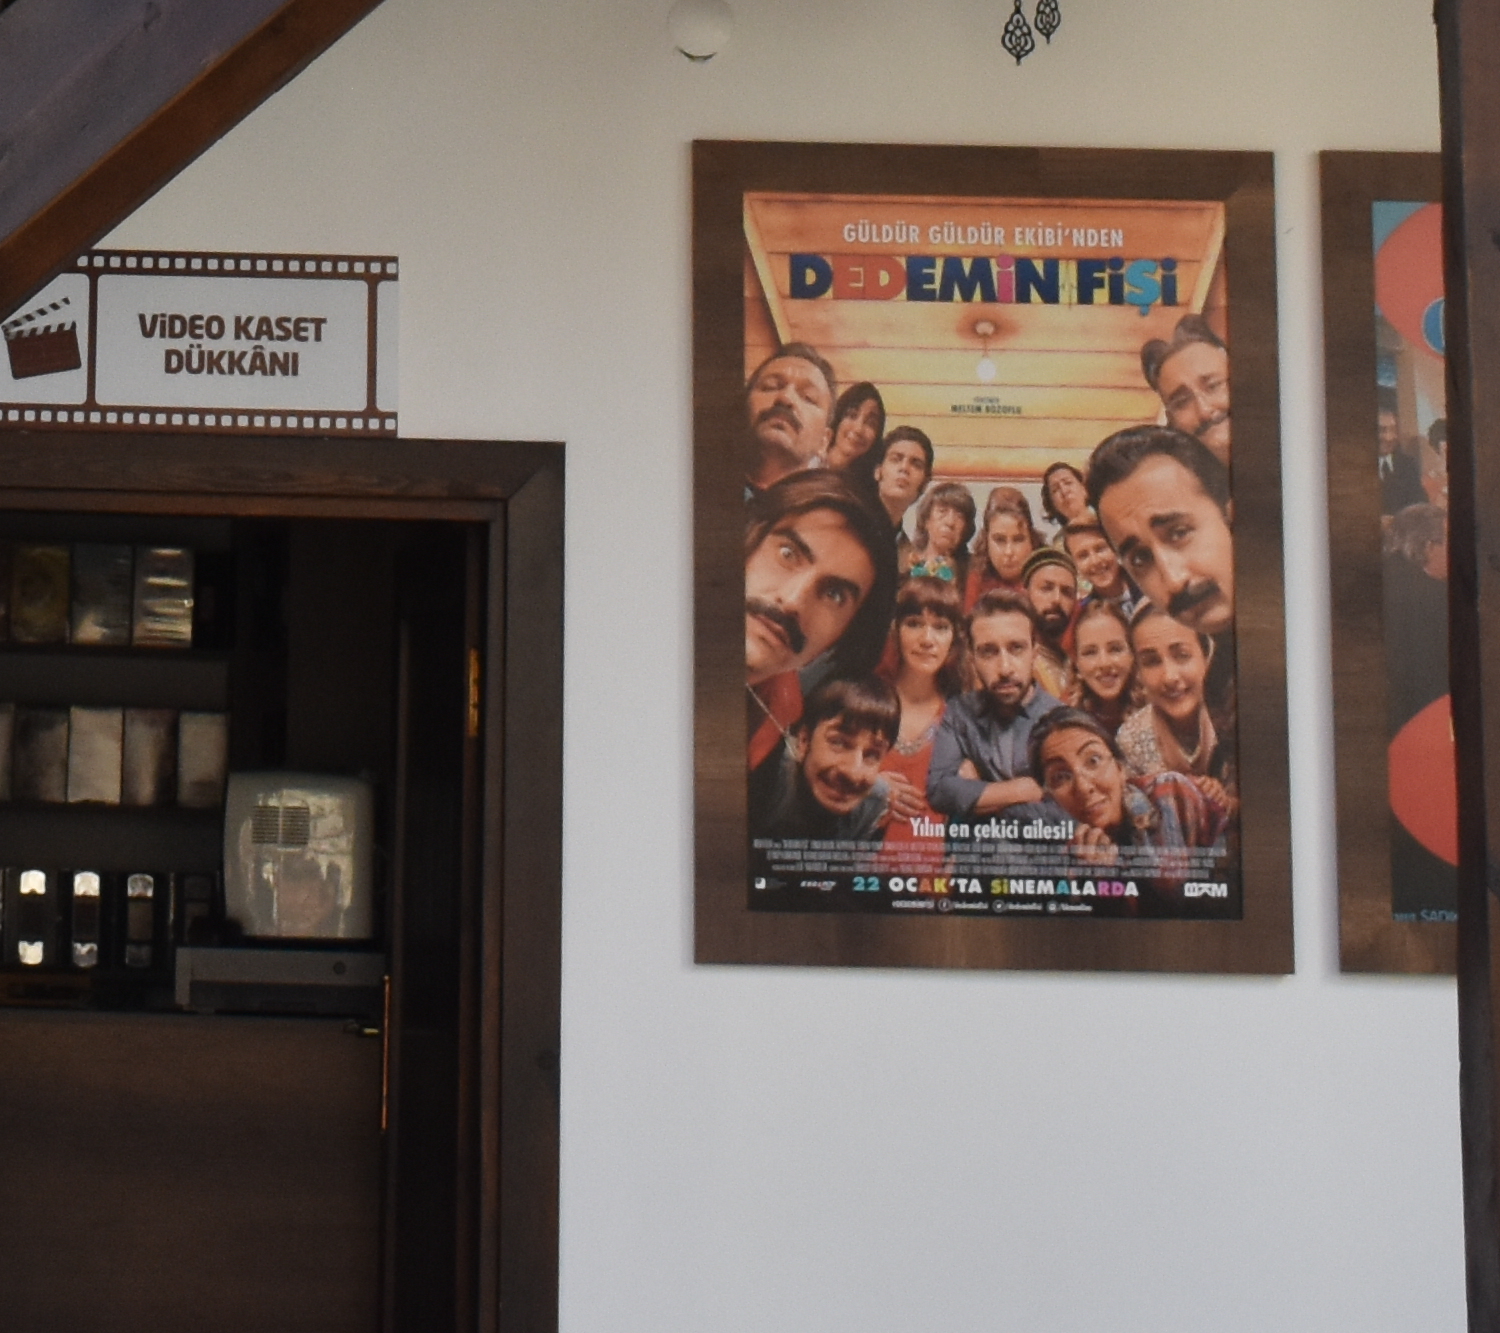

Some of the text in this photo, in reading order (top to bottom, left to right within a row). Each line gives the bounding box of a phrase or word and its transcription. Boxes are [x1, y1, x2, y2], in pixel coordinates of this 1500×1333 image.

[843, 220, 1123, 248] GÜLDÜR GÜLDÜR EKİBİ'NDEN
[789, 253, 1178, 316] DEDEMİN FİŞİ
[138, 312, 327, 342] VİDEO KASET
[164, 343, 299, 376] DÜKKÂNI
[909, 816, 1074, 842] Yılın en çekici ailesi!
[852, 876, 880, 893] 22
[888, 876, 982, 895] OCAK'TA
[991, 878, 1139, 897] SİNEMALARDA
